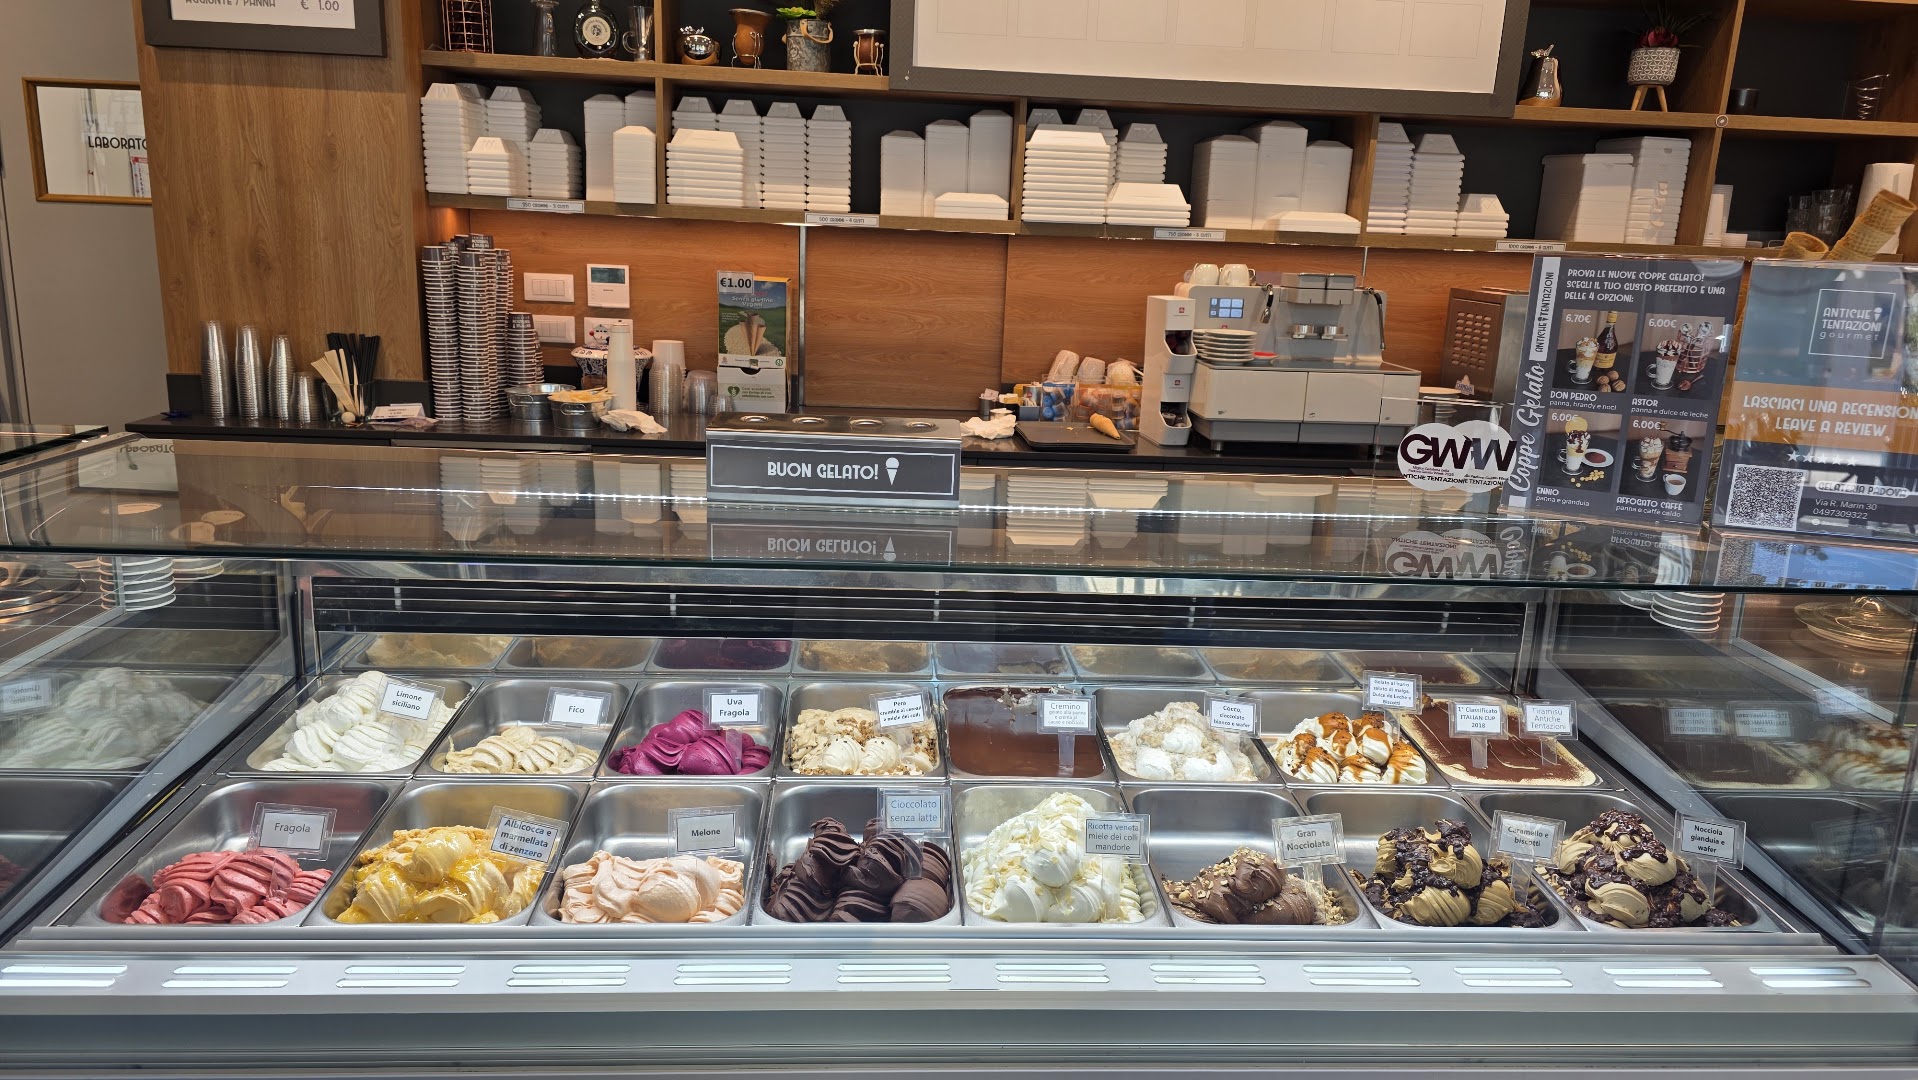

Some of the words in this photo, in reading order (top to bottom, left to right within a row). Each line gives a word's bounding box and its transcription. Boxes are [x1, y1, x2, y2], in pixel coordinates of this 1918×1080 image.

[301, 0, 309, 11] €
[319, 0, 340, 11] 1.00
[1567, 268, 1595, 278] PROVA
[1597, 269, 1606, 279] LE
[1608, 270, 1636, 280] NUOVE
[1639, 271, 1666, 281] COPPE
[1669, 272, 1704, 282] GELATO!
[720, 277, 752, 289] €1.00
[1566, 280, 1593, 289] SCEGLI
[1594, 281, 1600, 289] IL
[1603, 281, 1621, 290] TUO
[1624, 282, 1652, 292] GUSTO
[1654, 284, 1698, 294] PREFERITO
[1700, 285, 1706, 294] E
[1708, 286, 1725, 295] UNA
[1540, 271, 1555, 316] TENTAZIONI
[1564, 291, 1587, 300] DELLE
[1588, 292, 1594, 301] 4
[1597, 292, 1634, 303] OPZIONI:
[1565, 313, 1591, 324] 6.70€
[1822, 307, 1872, 320] ANTICHE
[1648, 318, 1677, 329] 6.00€
[1821, 319, 1882, 333] TENTAZIONI
[1534, 322, 1548, 353] ANTICHE
[1819, 331, 1879, 341] gourmet
[1516, 362, 1546, 427] Gelato
[1550, 391, 1568, 401] DON
[1572, 392, 1597, 402] PEDRO
[1631, 398, 1658, 407] ASTOR
[1743, 395, 1804, 412] LASCIACI
[1808, 399, 1837, 413] UNA
[1631, 406, 1653, 414] panna
[1658, 408, 1678, 417] dulce
[1679, 409, 1688, 417] de
[1775, 416, 1816, 432] LEAVE
[1820, 420, 1831, 433] A
[1834, 421, 1887, 437] REVIEW
[1507, 432, 1541, 492] Coppe
[767, 461, 812, 478] BUON
[816, 463, 879, 480] GELATO!
[1536, 487, 1559, 496] ENNIO
[1818, 481, 1865, 495] GELATERIA
[1867, 484, 1908, 498] PADOVA
[1616, 496, 1658, 507] AFFOGATO
[1815, 498, 1828, 507] Via
[1829, 500, 1839, 508] R.
[1865, 503, 1877, 511] 30
[1813, 508, 1868, 520] 0497309322
[396, 690, 423, 702] Limone
[391, 698, 421, 711] siciliano
[727, 698, 743, 706] Uva
[1050, 702, 1081, 711] Cremino
[568, 705, 585, 714] Fico
[719, 709, 750, 718] Fragola
[1465, 706, 1498, 714] Classificato
[1532, 707, 1563, 716] Tiramisù
[1530, 722, 1566, 730] Tentazioni
[890, 799, 937, 809] Cioccolato
[890, 814, 915, 822] senza
[918, 812, 938, 822] latte
[274, 822, 311, 834] Fragola
[504, 819, 545, 835] Albicocca
[1088, 822, 1113, 831] Ricotta
[1114, 823, 1139, 831] veneta
[1507, 826, 1543, 838] Caramello
[1694, 824, 1723, 836] Nocciola
[691, 828, 721, 837] Melone
[1088, 831, 1109, 840] miele
[1110, 833, 1122, 841] dei
[1296, 829, 1317, 838] Gran
[500, 831, 549, 848] marmellata
[1514, 836, 1541, 847] biscotti
[1690, 834, 1720, 845] gianduia
[500, 842, 508, 850] di
[509, 845, 543, 858] zenzero
[1095, 843, 1131, 851] mandorle
[1286, 840, 1331, 851] Nocciolata
[1697, 845, 1717, 854] wafer
